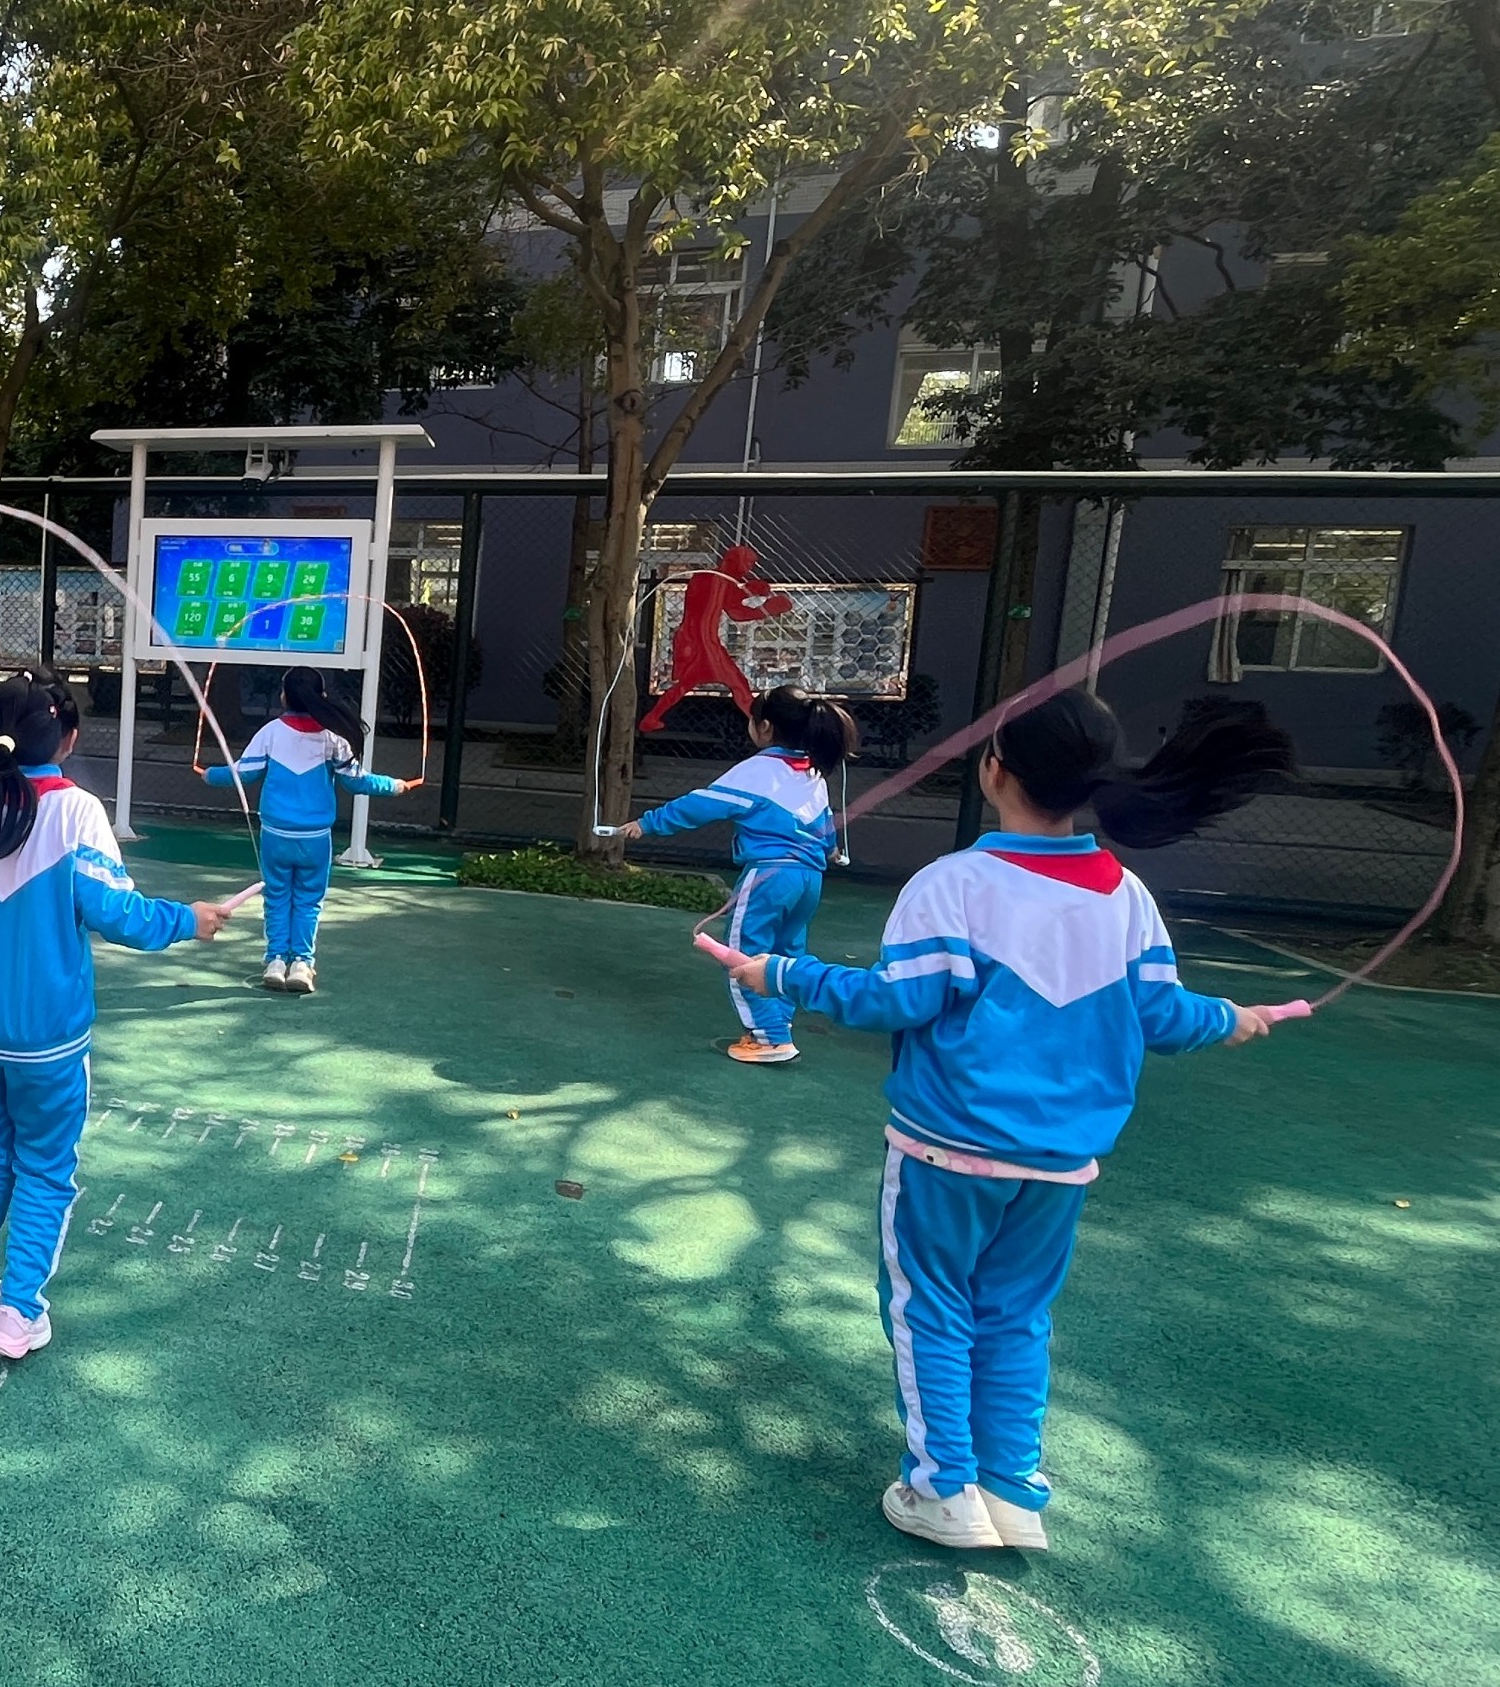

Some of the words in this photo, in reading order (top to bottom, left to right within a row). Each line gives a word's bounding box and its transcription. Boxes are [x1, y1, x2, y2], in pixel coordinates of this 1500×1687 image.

[228, 573, 235, 583] 6
[266, 574, 274, 584] 9
[184, 612, 201, 622] 120
